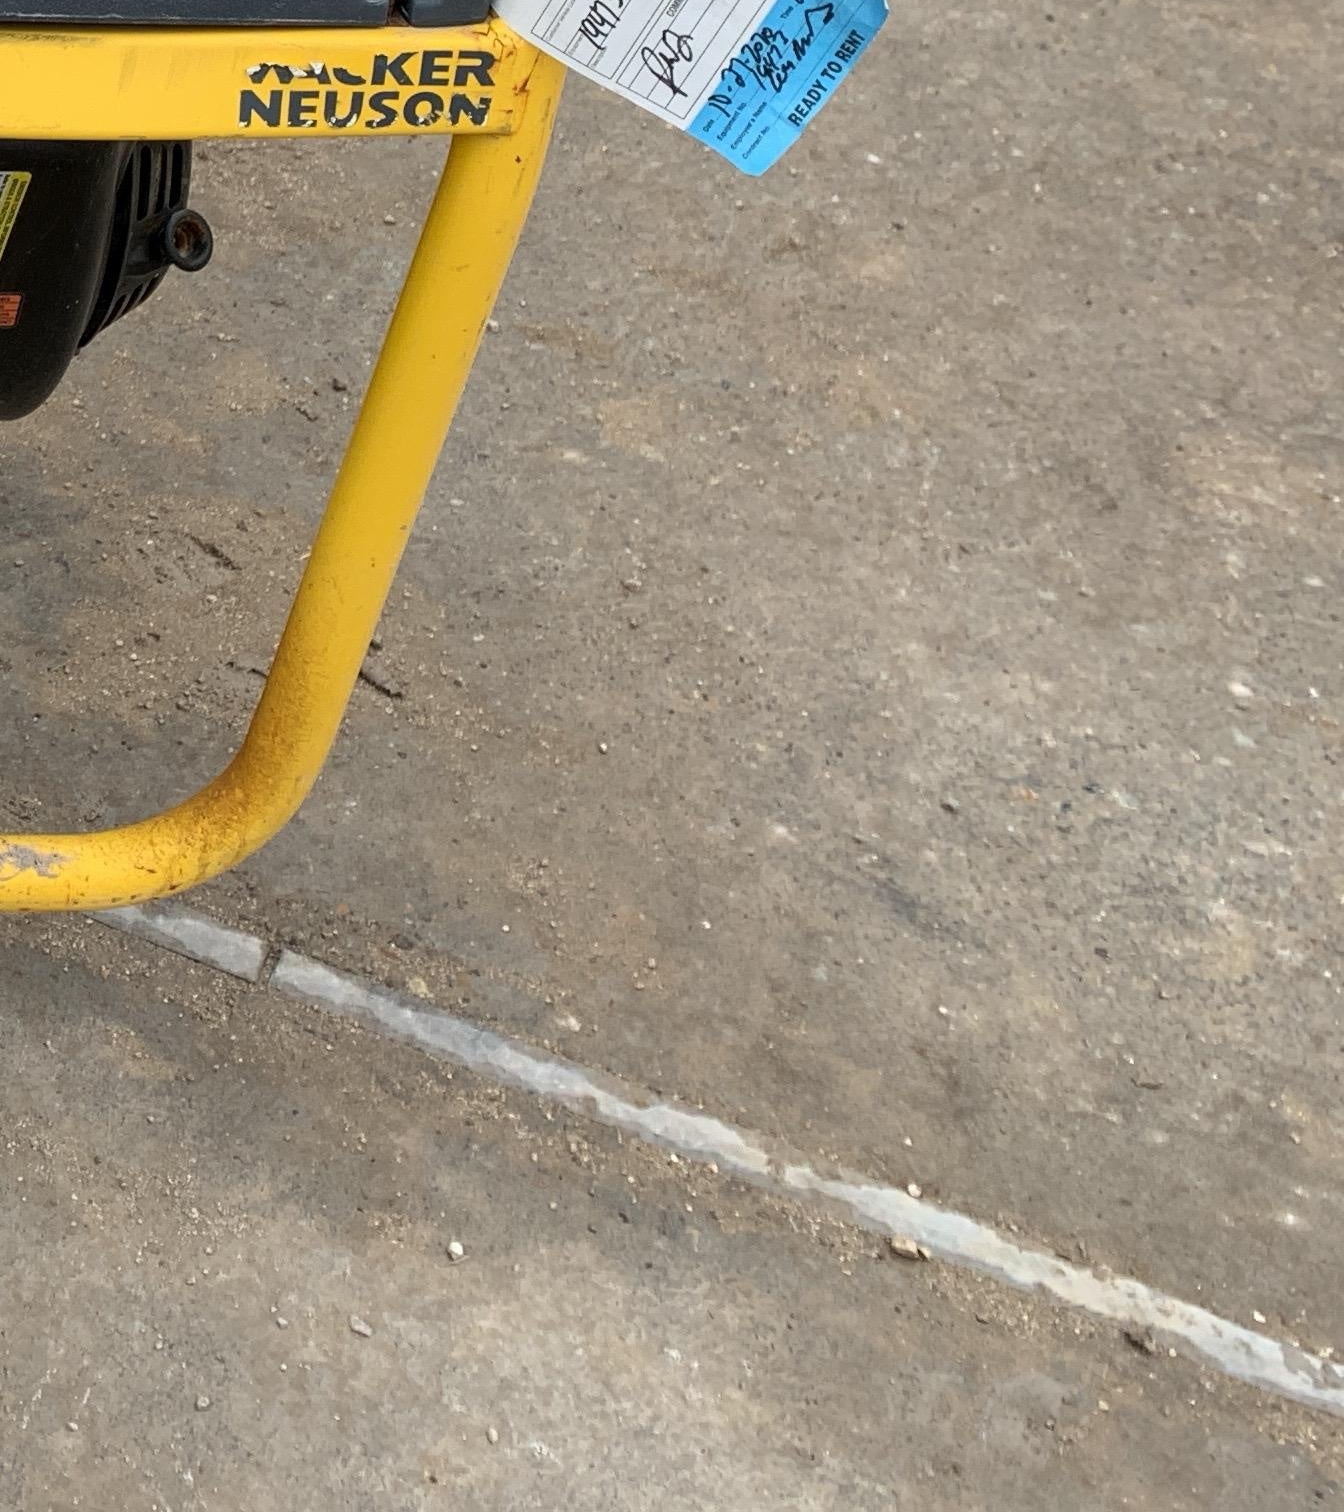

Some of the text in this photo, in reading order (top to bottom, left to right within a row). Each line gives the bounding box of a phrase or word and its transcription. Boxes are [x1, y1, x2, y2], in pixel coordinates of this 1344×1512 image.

[238, 89, 492, 129] NEUSON
[788, 79, 828, 127] READY
[821, 61, 843, 82] TO
[835, 29, 866, 64] RENT
